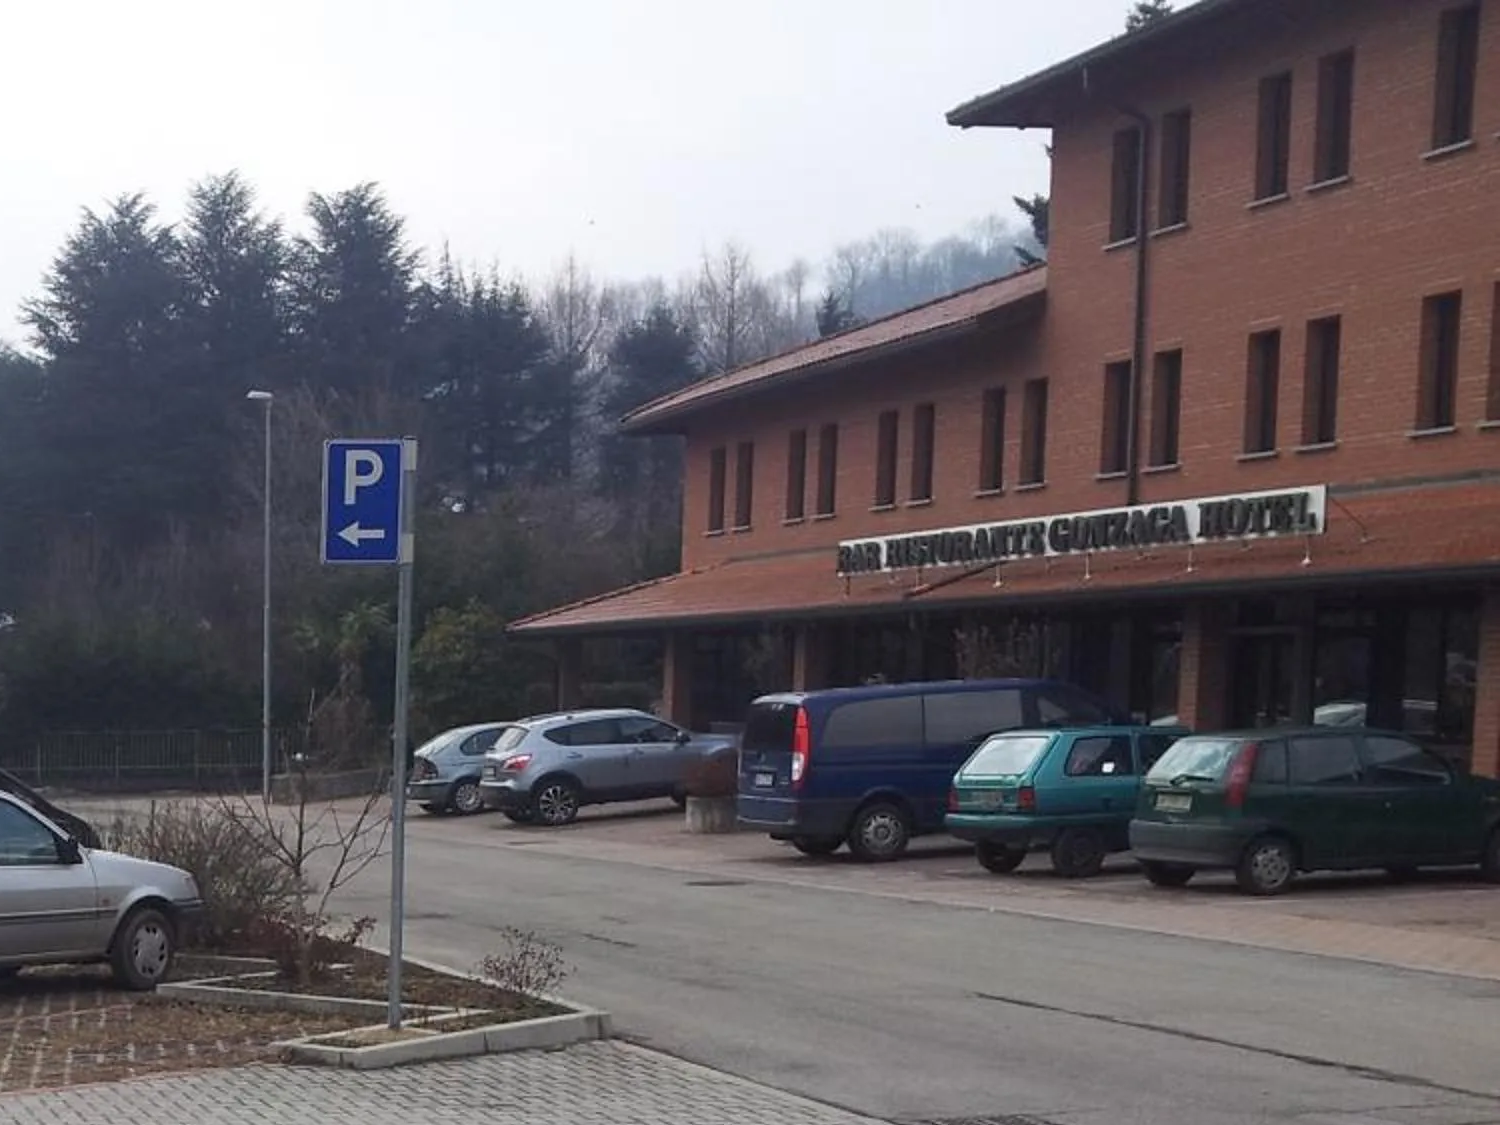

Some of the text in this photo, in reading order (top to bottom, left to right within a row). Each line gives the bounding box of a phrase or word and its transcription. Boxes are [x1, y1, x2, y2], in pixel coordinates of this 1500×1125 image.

[344, 450, 384, 505] P
[838, 493, 1316, 574] BAR RISTORANTE GONZAGA HOTEL
